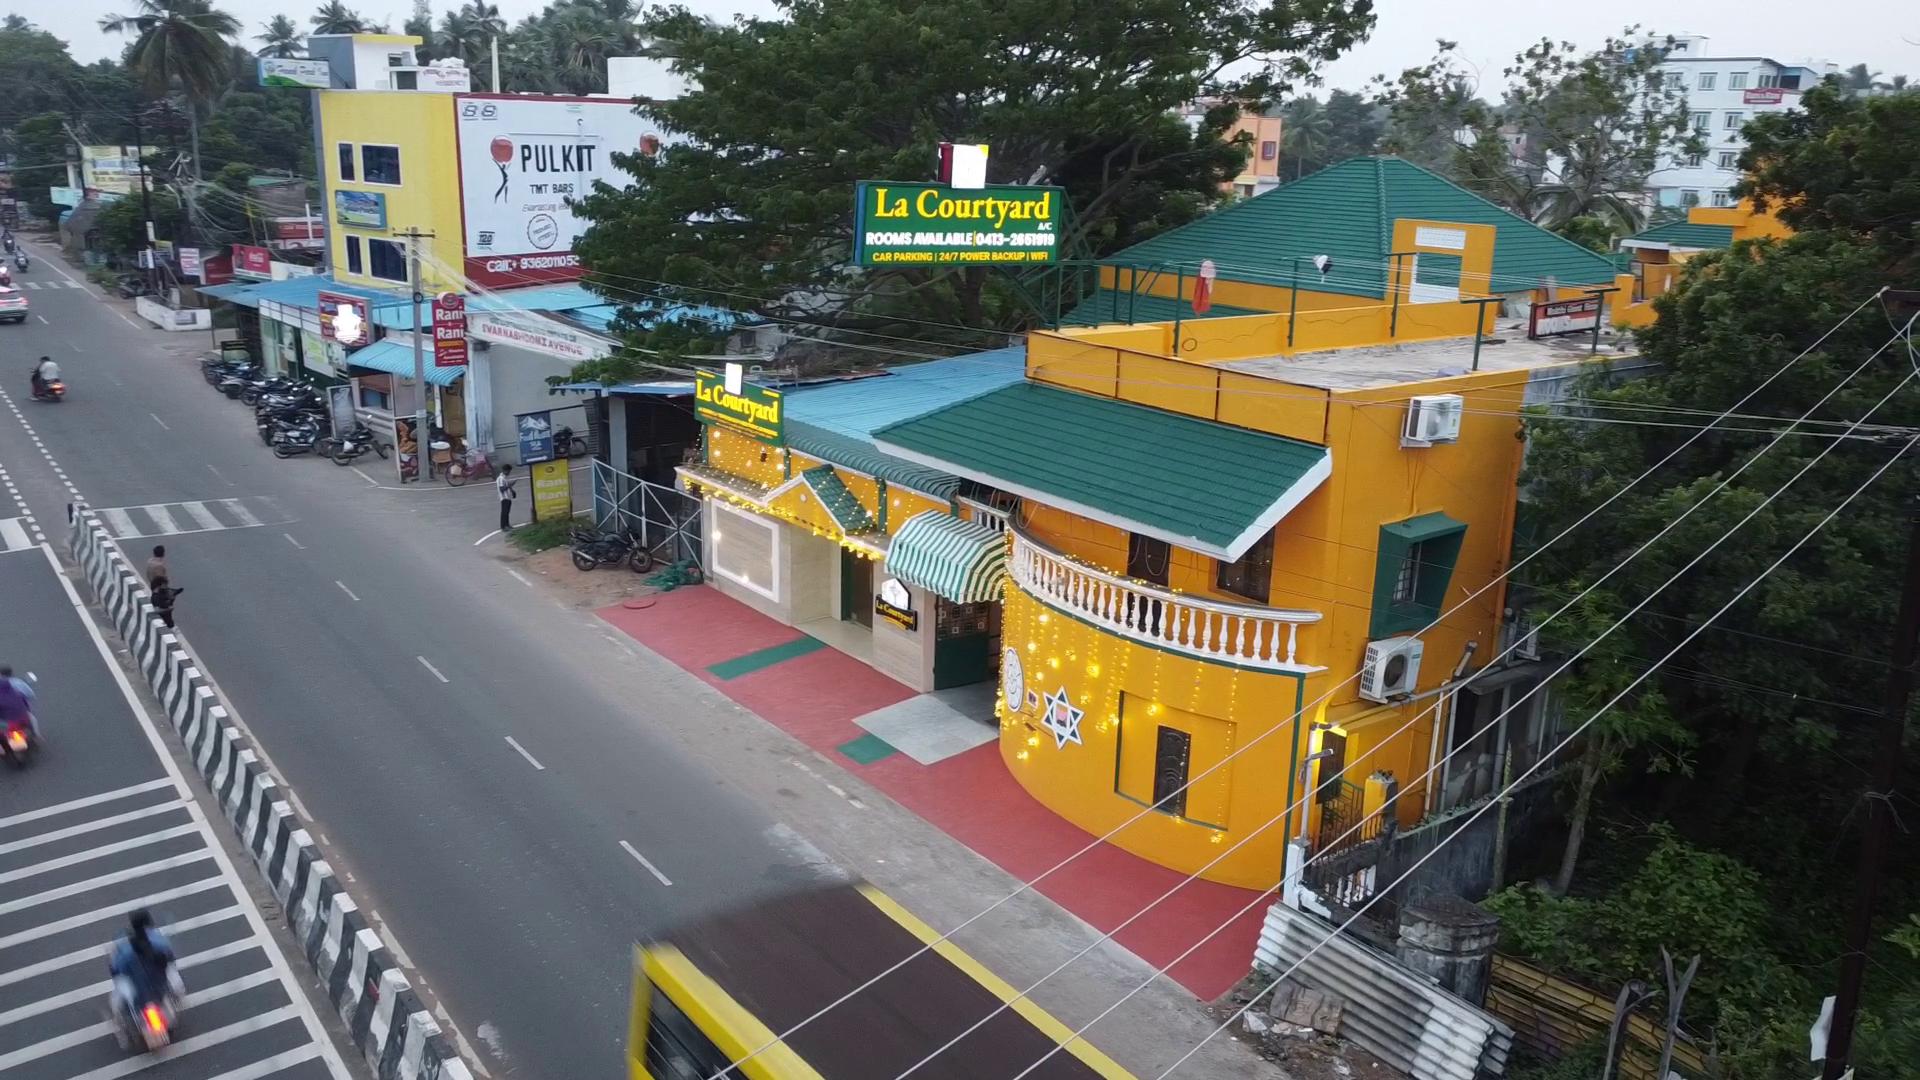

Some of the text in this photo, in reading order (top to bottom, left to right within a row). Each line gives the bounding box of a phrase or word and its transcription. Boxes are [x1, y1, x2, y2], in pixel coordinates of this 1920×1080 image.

[521, 144, 596, 173] PULKIT
[530, 183, 574, 195] TMT BARS
[875, 188, 1051, 229] La Courtyard
[1037, 222, 1053, 231] A/C
[865, 231, 912, 246] ROOMS
[912, 231, 973, 246] AVAILABLE
[872, 251, 1048, 262] CAR PARKING 24/7 POWER BACKUP WIFI
[435, 305, 465, 321] Rani
[436, 324, 465, 340] Rani
[547, 340, 583, 356] AVENUE
[696, 378, 779, 423] La Courtyard
[876, 599, 884, 610] La
